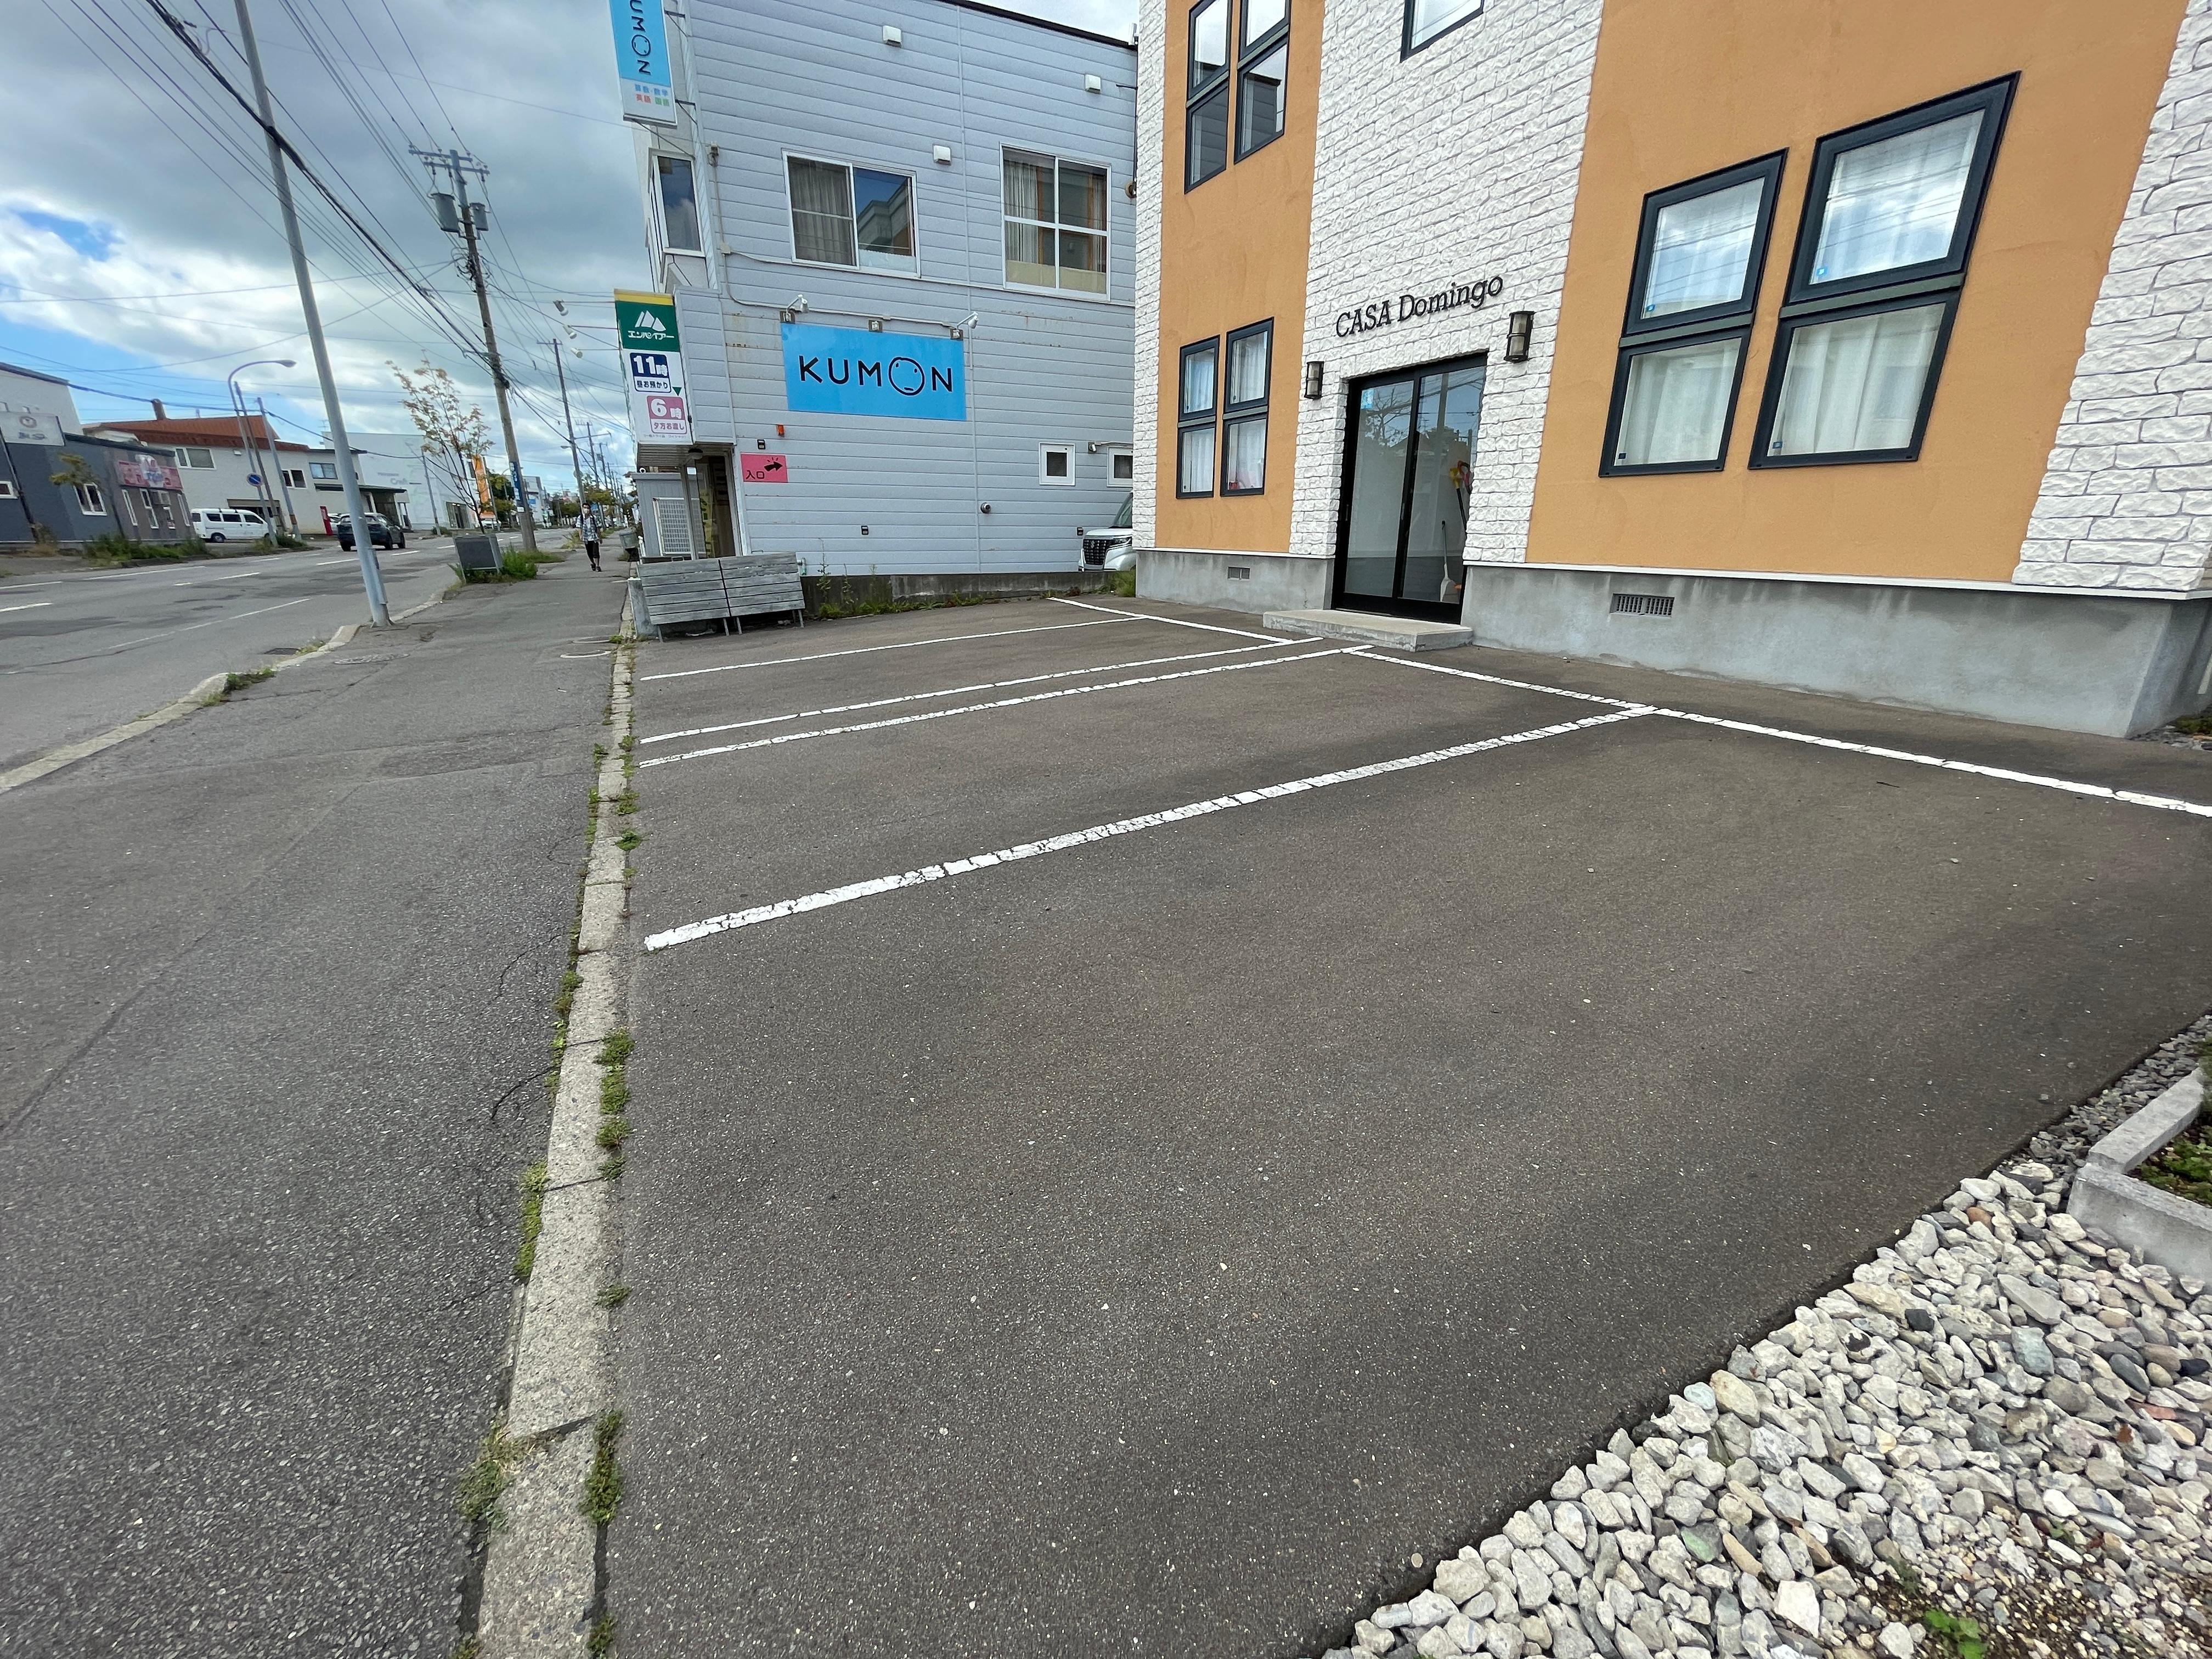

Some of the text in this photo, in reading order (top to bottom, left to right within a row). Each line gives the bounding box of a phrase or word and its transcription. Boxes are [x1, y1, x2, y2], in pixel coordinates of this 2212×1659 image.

[1335, 276, 1503, 337] CASA Domingo
[628, 330, 675, 340] エンパイアー
[799, 355, 952, 396] KUMON
[746, 470, 765, 479] 入口
